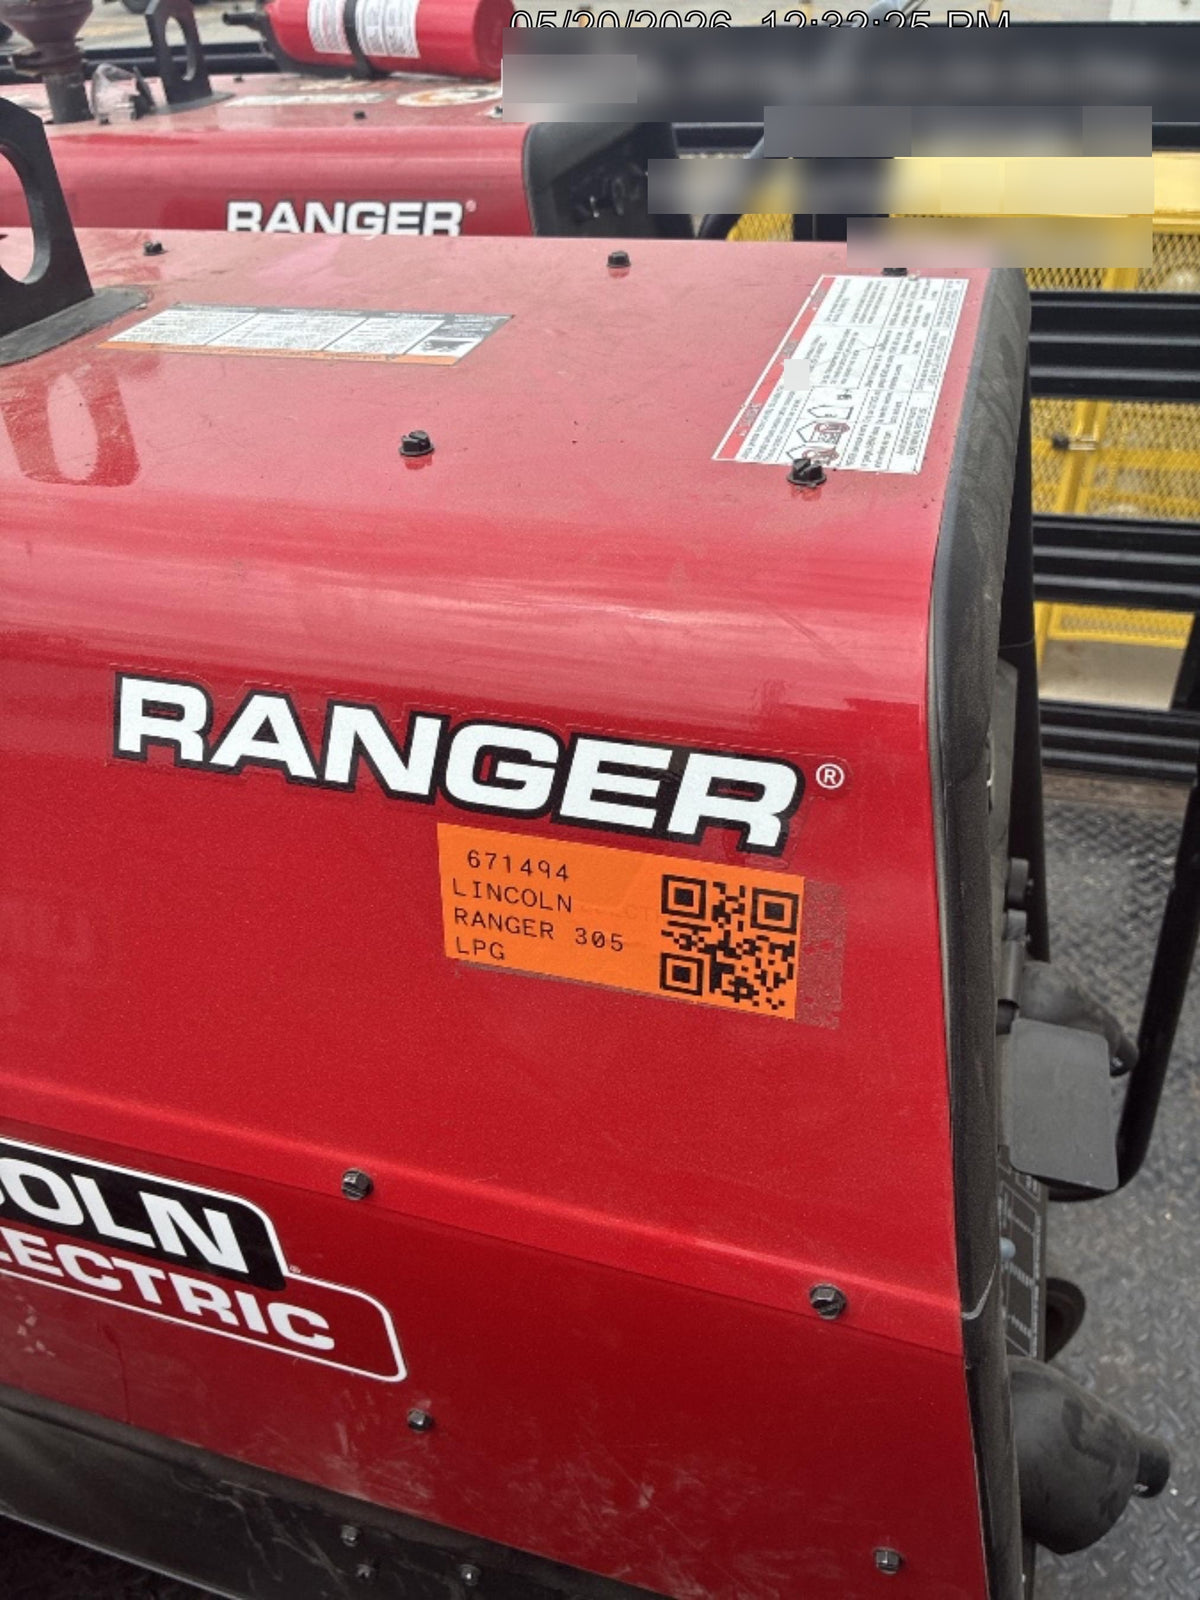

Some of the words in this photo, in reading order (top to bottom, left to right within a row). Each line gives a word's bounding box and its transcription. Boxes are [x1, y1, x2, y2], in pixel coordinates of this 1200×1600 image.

[467, 850, 569, 882] 671494
[453, 878, 572, 913] LINCOLN
[454, 907, 554, 940] RANGER
[575, 927, 623, 952] 305
[456, 936, 505, 961] LPG
[0, 1158, 249, 1274] OLN
[0, 1227, 335, 1350] ECTRIC
